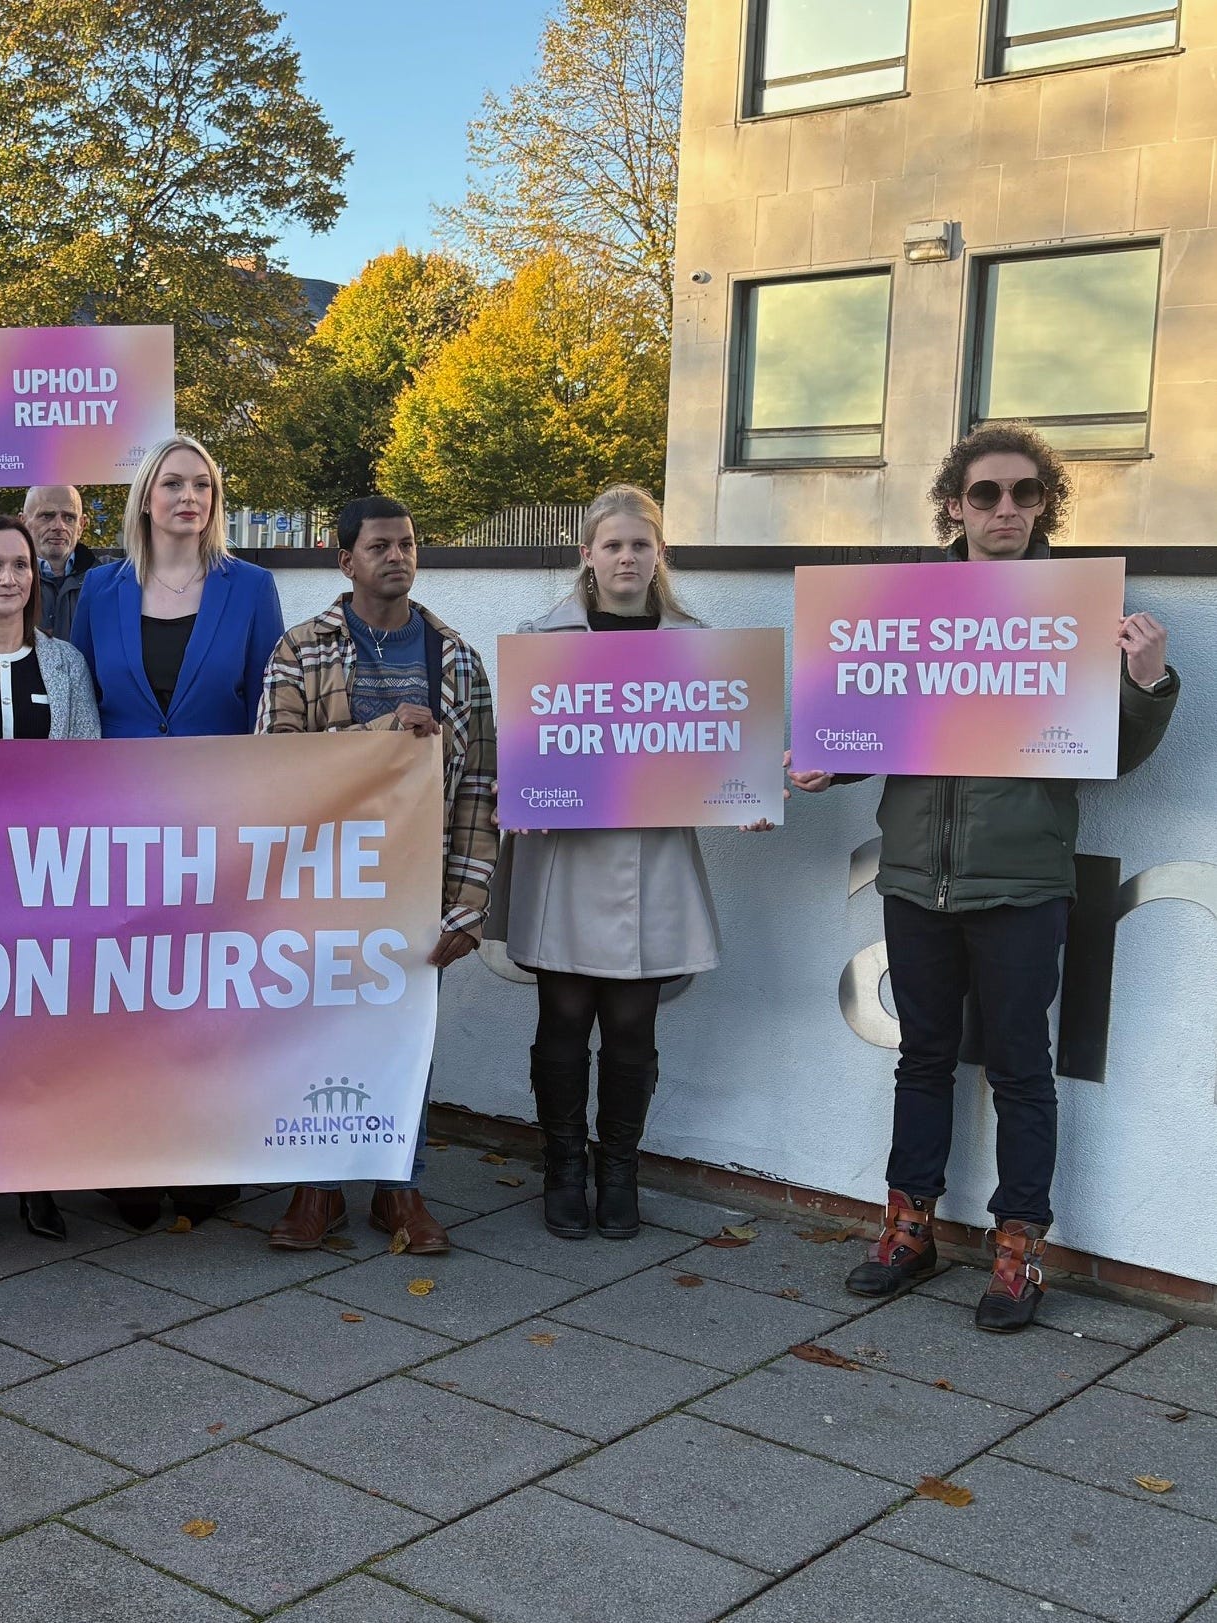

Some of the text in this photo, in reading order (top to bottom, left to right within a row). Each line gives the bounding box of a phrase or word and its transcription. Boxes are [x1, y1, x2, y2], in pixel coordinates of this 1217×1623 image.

[13, 367, 117, 394] UPHOLD
[15, 400, 118, 426] REALITY
[829, 616, 1078, 652] SAFE SPACES
[836, 661, 1066, 696] FOR WOMEN
[530, 680, 749, 715] SAFE SPACES
[539, 720, 740, 755] FOR WOMEN
[815, 728, 877, 742] Christian
[824, 738, 883, 751] Concern
[520, 787, 577, 800] Christian
[528, 797, 583, 808] Concern
[8, 824, 216, 908] WITH
[238, 819, 386, 900] THE
[93, 928, 409, 1017] NURSES
[275, 1115, 395, 1133] DARLINGTON
[264, 1133, 406, 1147] NURSING UNION
